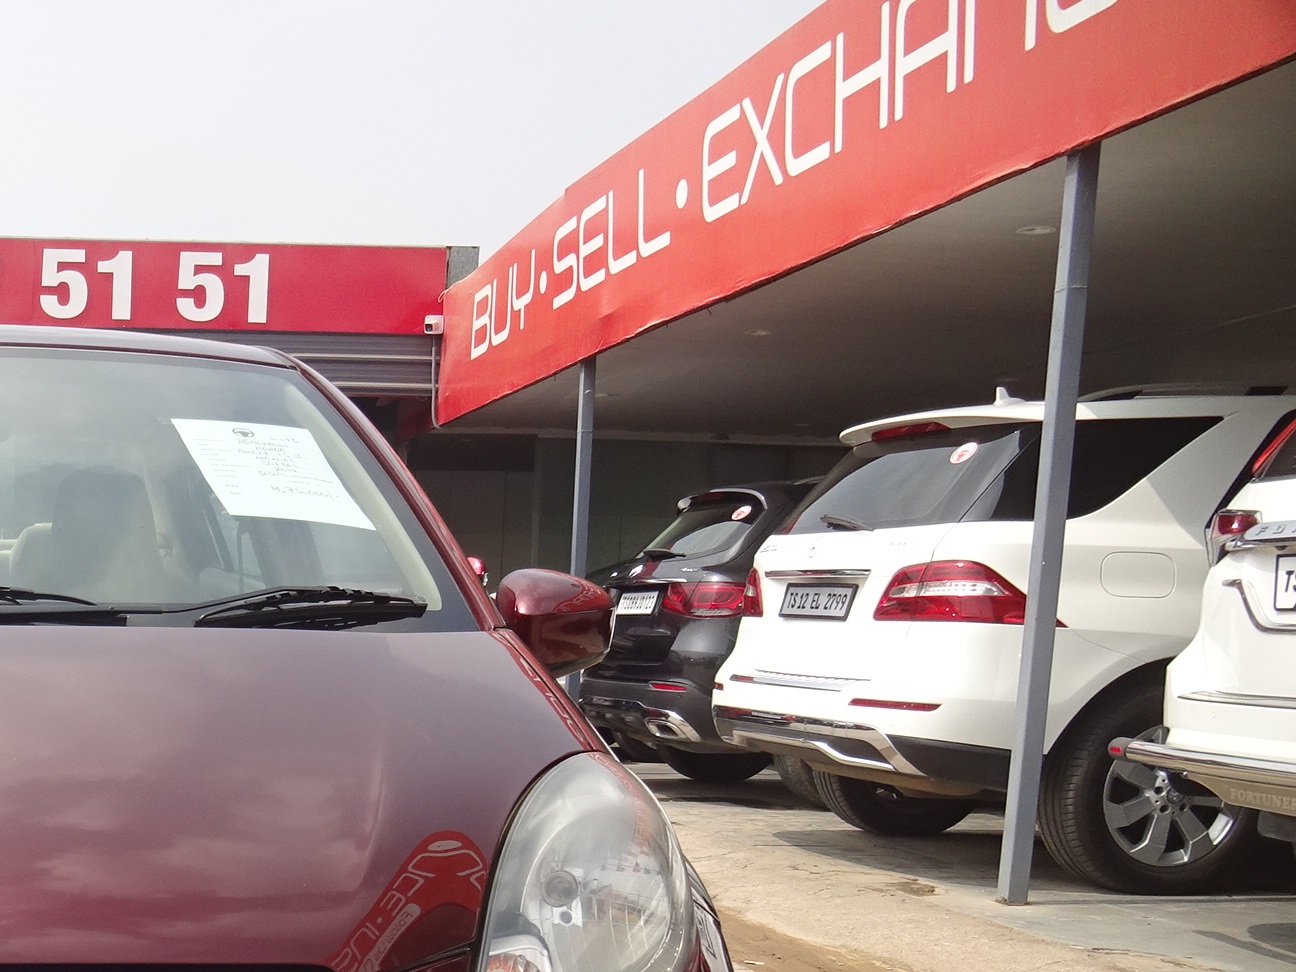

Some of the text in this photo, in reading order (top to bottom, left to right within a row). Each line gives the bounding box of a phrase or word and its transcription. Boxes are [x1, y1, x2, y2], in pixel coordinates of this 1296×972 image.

[39, 248, 133, 321] 51
[175, 251, 270, 324] 51
[470, 249, 535, 360] BUY
[553, 168, 670, 310] SELL
